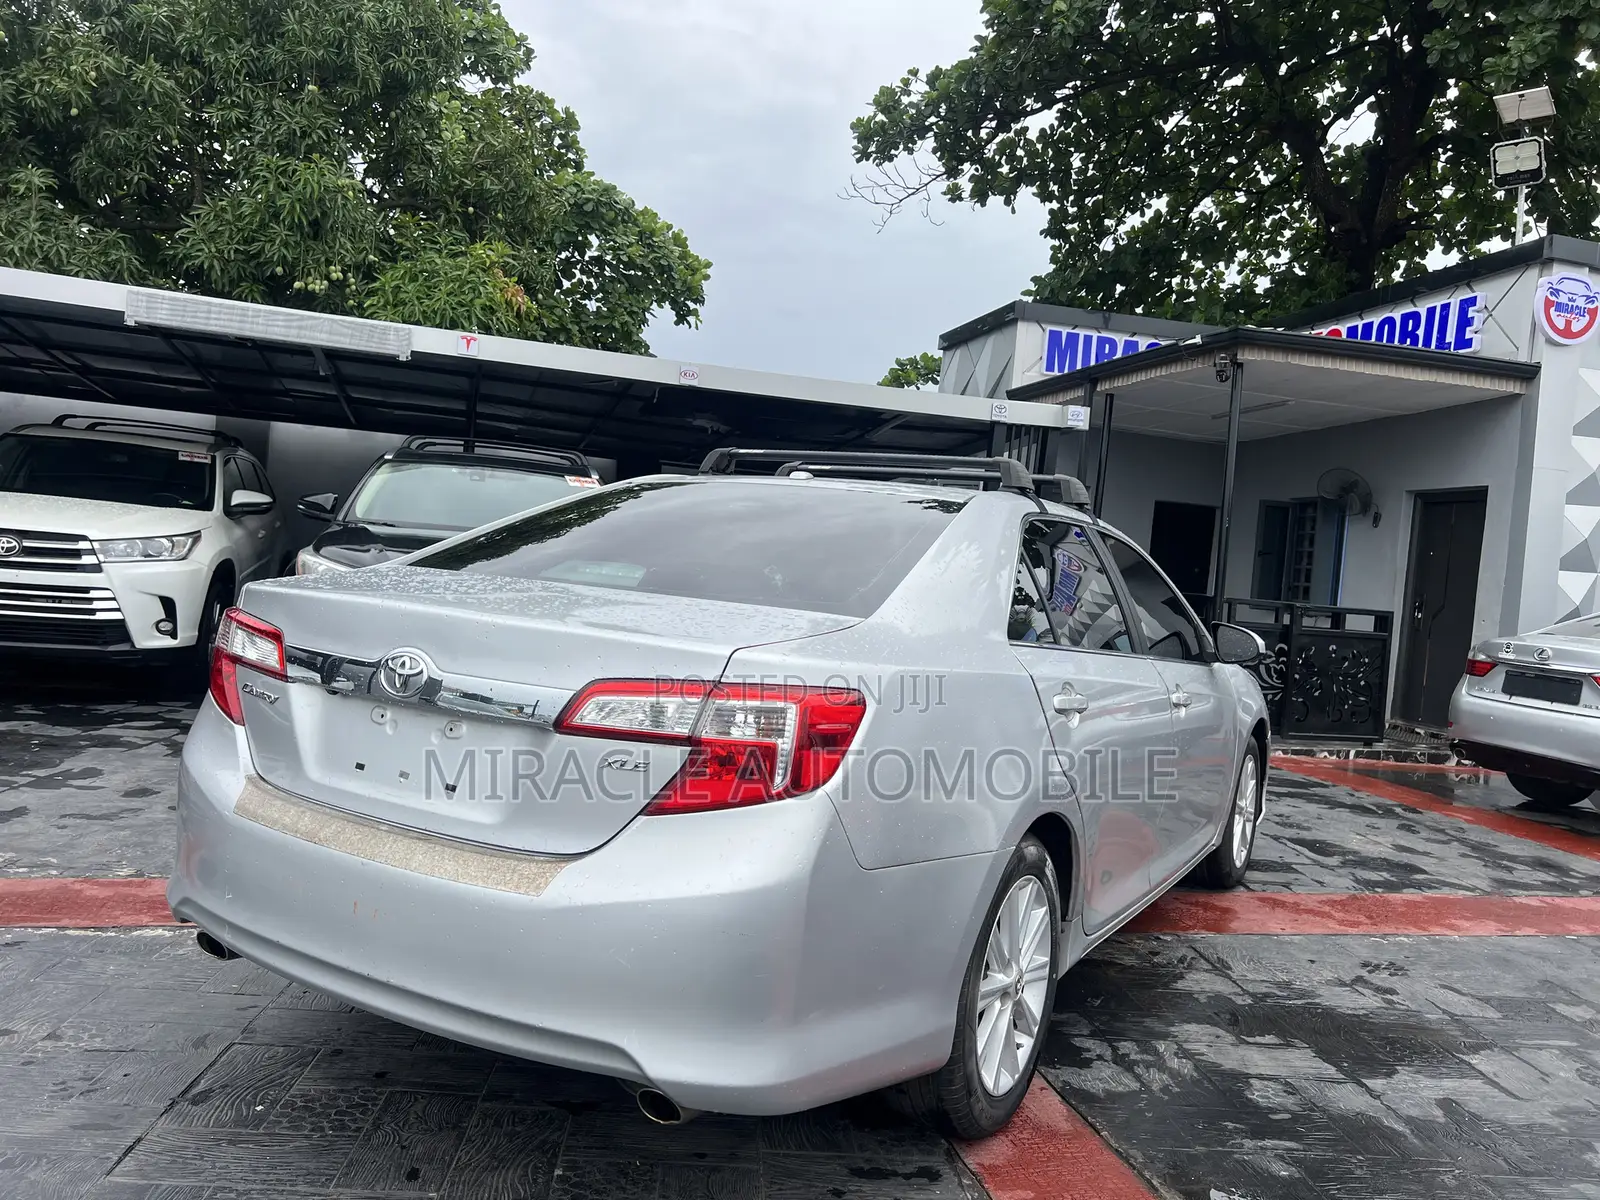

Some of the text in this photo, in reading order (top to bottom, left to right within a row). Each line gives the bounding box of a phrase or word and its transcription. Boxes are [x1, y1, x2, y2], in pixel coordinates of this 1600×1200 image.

[1554, 300, 1587, 318] MIRACLE
[1045, 295, 1478, 374] MIR OBILE
[600, 757, 651, 773] XLE
